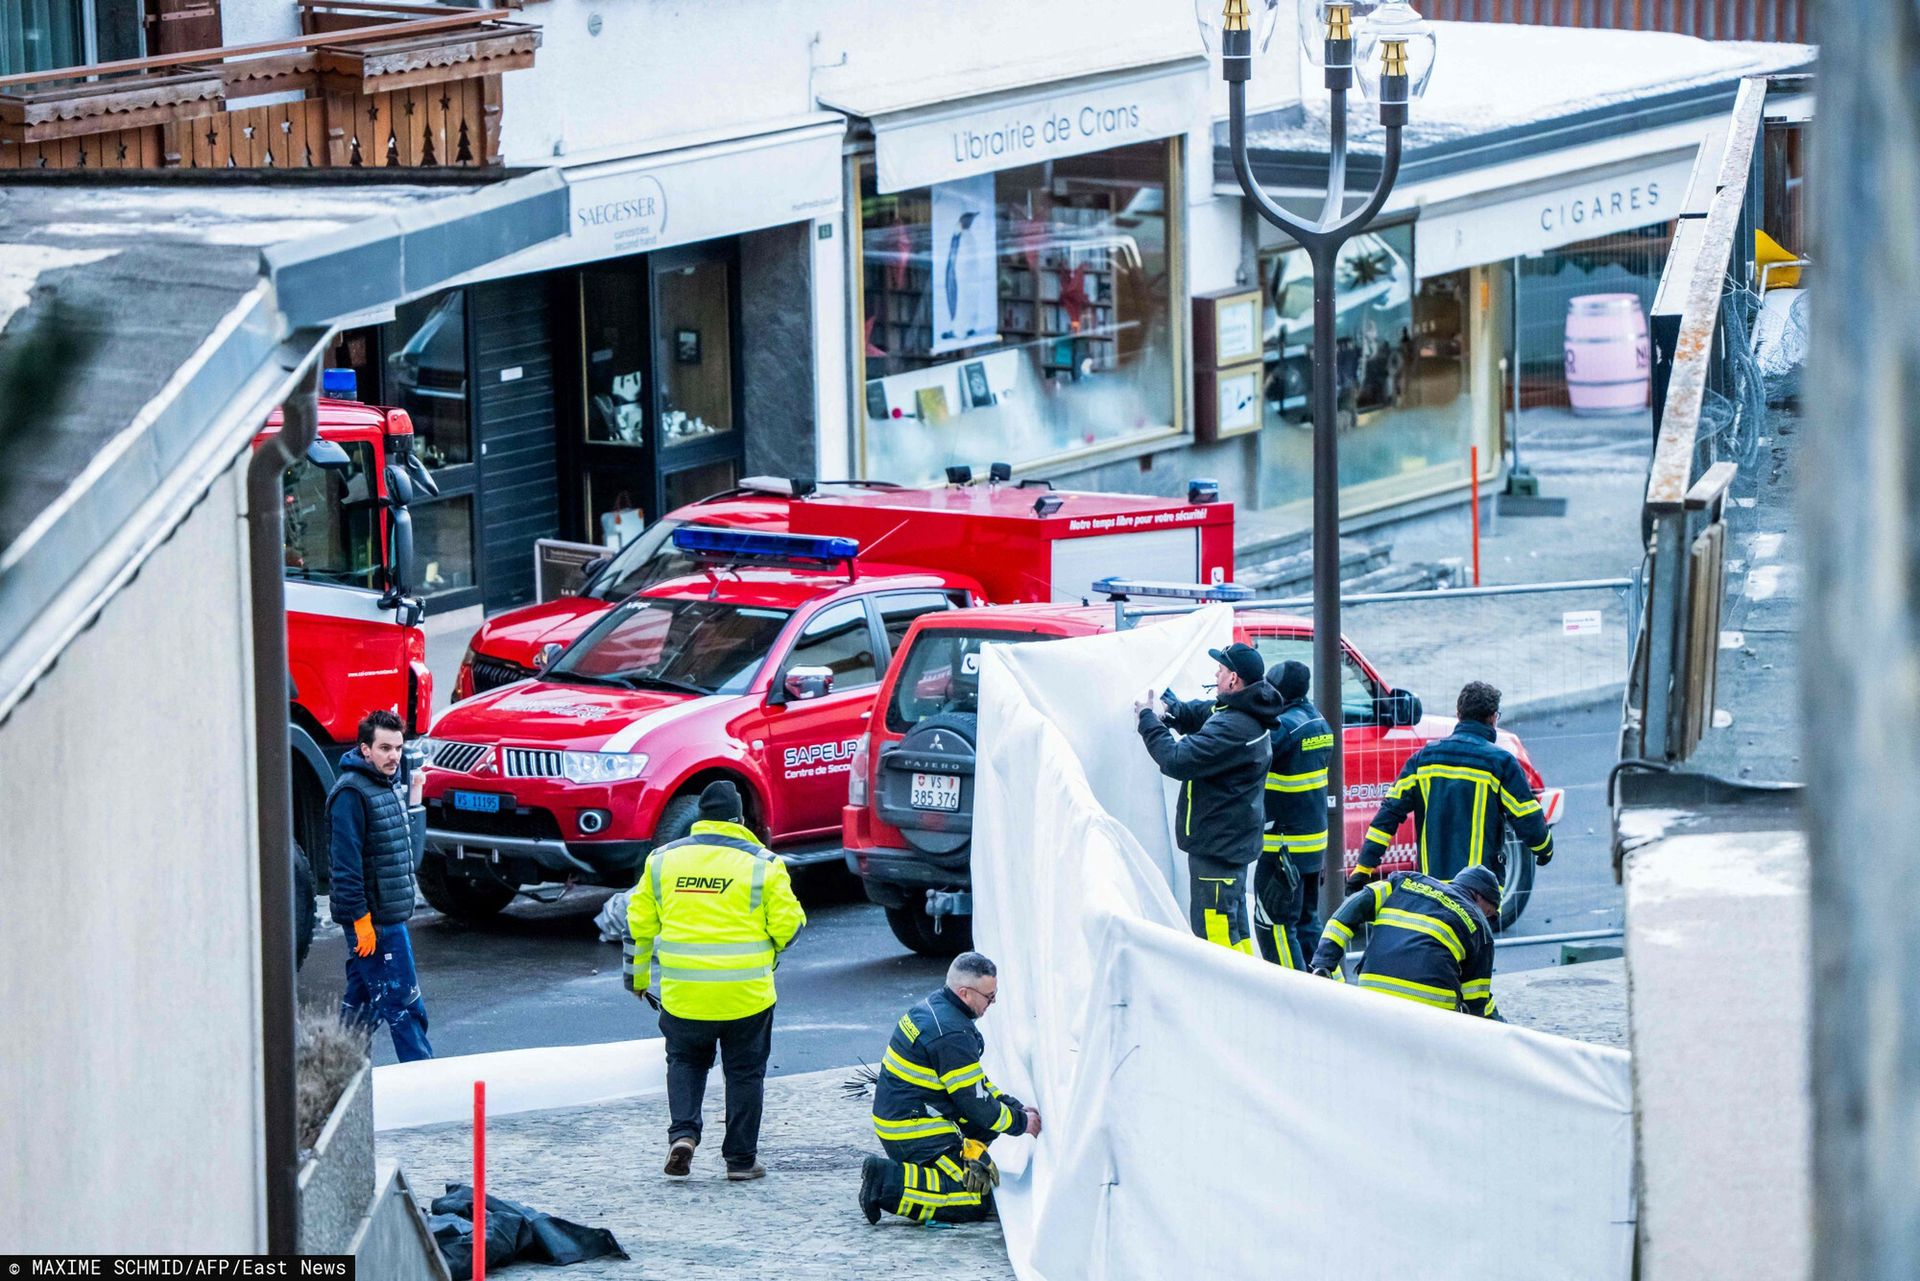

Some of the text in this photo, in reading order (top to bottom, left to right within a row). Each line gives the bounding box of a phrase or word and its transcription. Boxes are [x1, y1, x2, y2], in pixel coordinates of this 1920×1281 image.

[953, 103, 1140, 162] Librairie de Crans
[577, 196, 656, 226] SAEGESSER
[1540, 182, 1659, 231] CIGARES
[1069, 519, 1091, 530] Notre
[1092, 517, 1115, 530] temps
[1116, 515, 1133, 526] libre
[1134, 514, 1153, 527] pour
[1154, 511, 1174, 523] votre
[784, 739, 859, 767] SAPEUR
[784, 763, 852, 780] Centre de Seco
[904, 759, 960, 770] PAJERO
[930, 775, 942, 789] VS
[914, 791, 957, 808] 385 376
[675, 876, 734, 894] EPINEY
